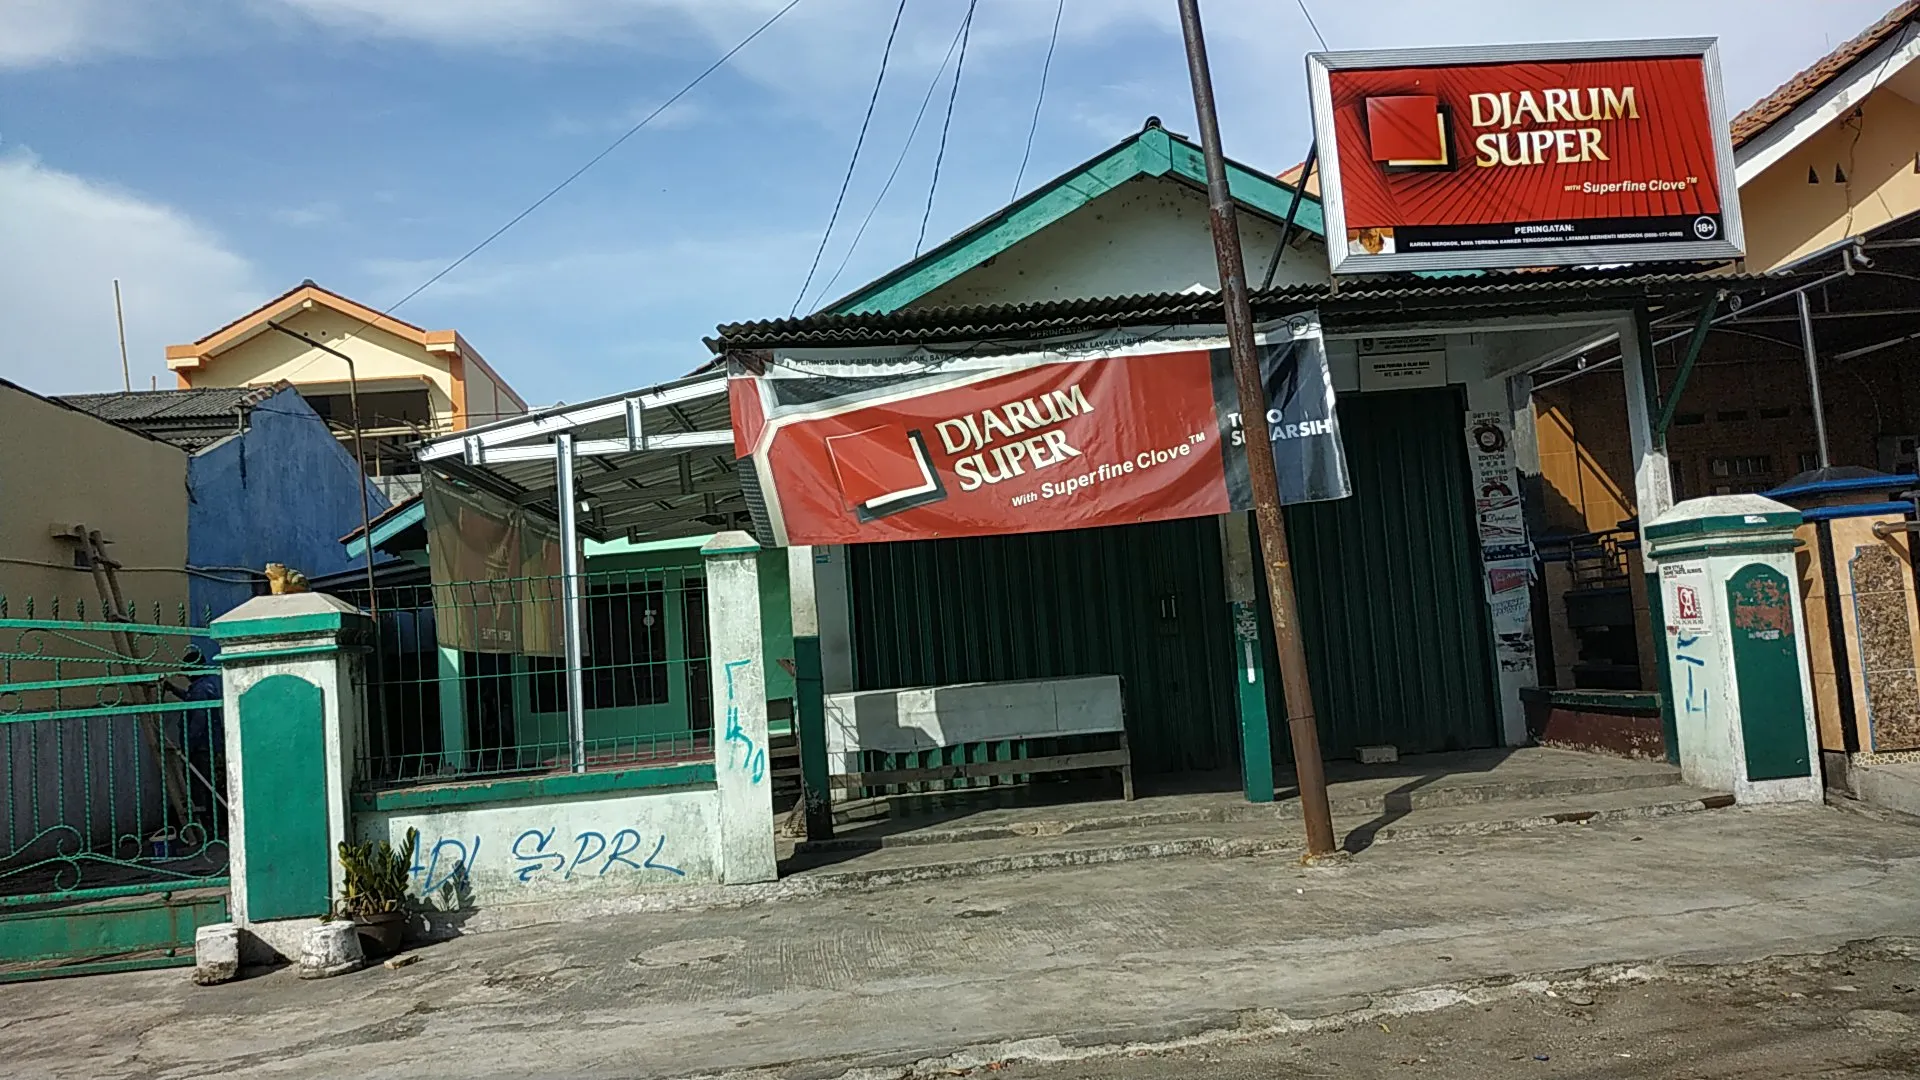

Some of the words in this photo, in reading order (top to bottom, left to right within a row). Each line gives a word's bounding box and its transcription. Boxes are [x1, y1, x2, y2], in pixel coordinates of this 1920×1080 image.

[1469, 86, 1639, 129] DJARUM
[1475, 127, 1611, 168] SUPER
[1564, 184, 1582, 192] WITH
[1582, 179, 1648, 195] Superfine
[1514, 223, 1576, 235] PERINGATAN:
[1696, 221, 1714, 233] 18+
[936, 384, 1094, 456] DJARUM
[1227, 408, 1283, 428] TO
[953, 428, 1082, 492] SUPER
[1011, 491, 1038, 508] With
[1040, 459, 1135, 500] Superfine
